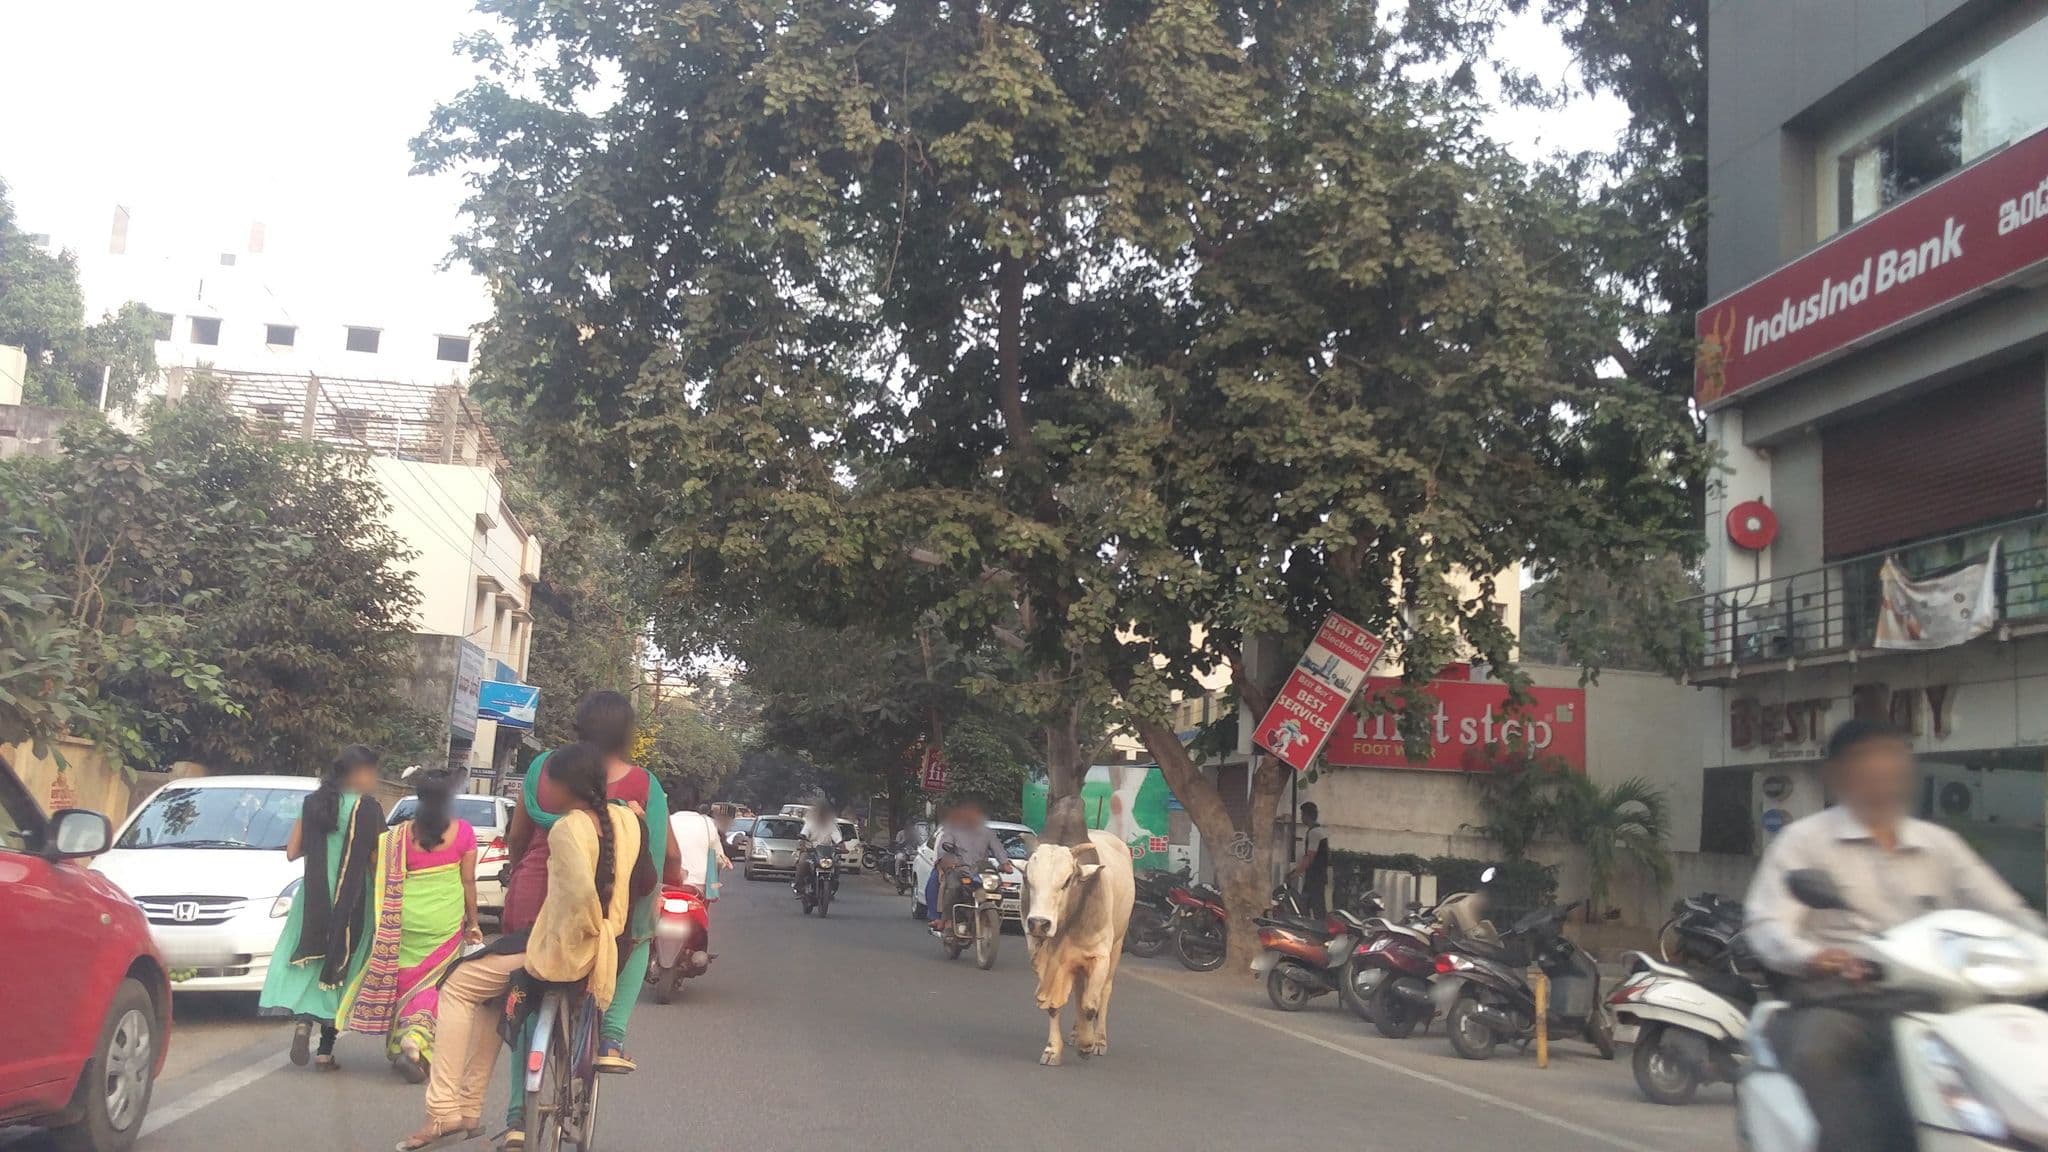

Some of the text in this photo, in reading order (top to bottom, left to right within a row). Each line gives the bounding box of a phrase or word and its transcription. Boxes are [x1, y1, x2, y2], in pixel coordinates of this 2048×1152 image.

[1743, 215, 1966, 355] IndusInd Bank
[1320, 631, 1370, 665] Electronics
[1278, 694, 1332, 732] SERVICES
[1296, 689, 1328, 713] BEST
[1353, 743, 1391, 756] FOOT
